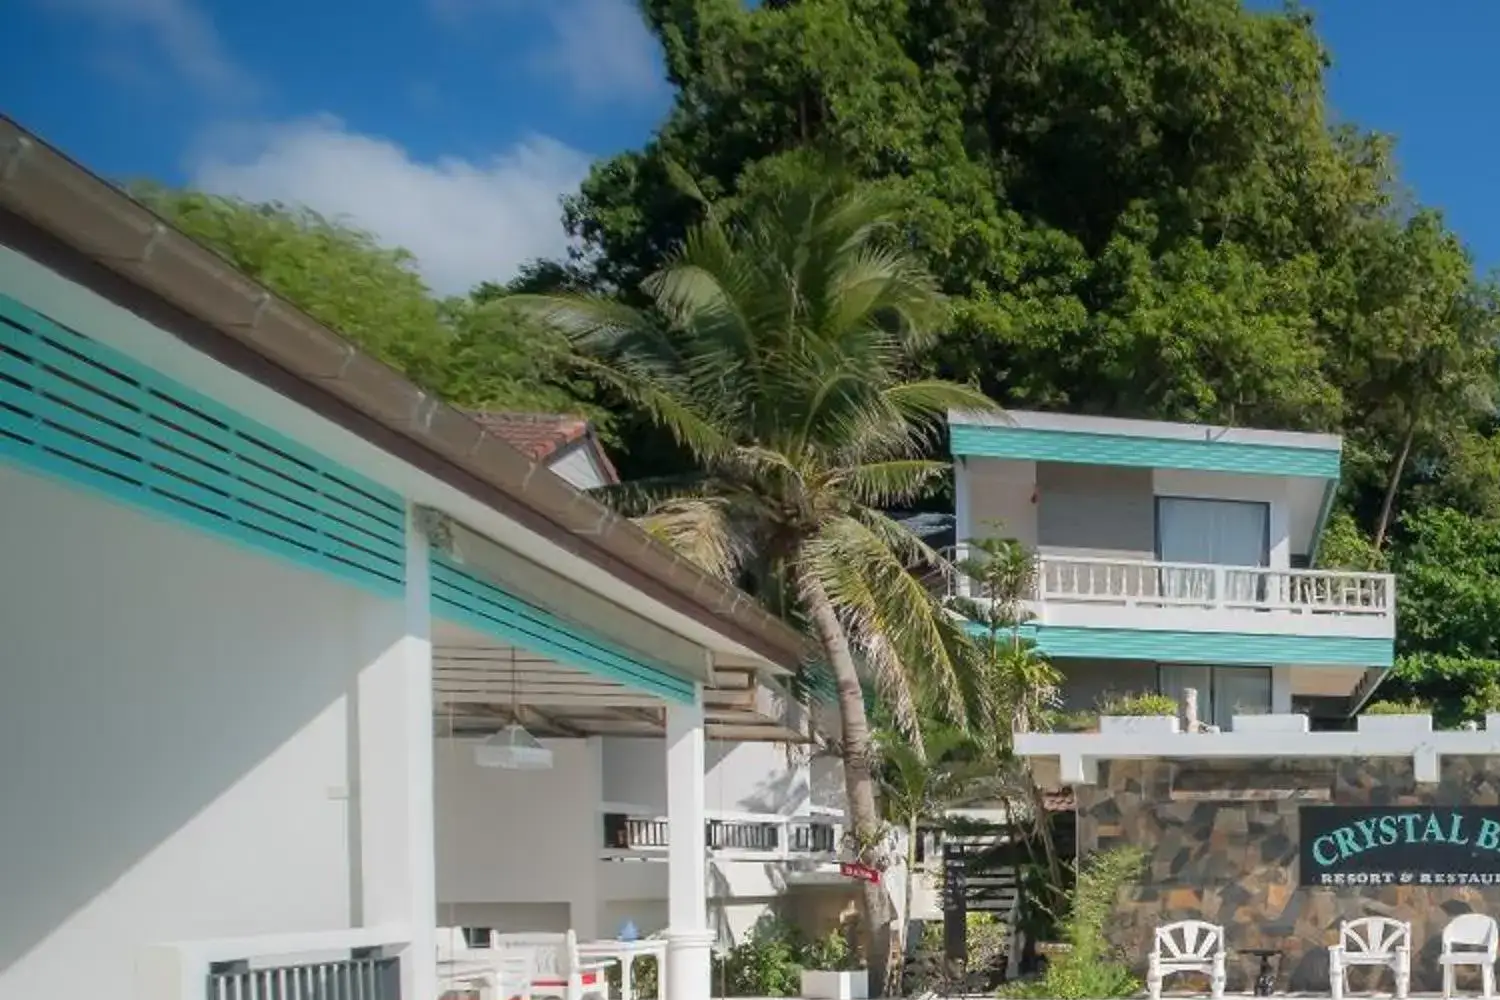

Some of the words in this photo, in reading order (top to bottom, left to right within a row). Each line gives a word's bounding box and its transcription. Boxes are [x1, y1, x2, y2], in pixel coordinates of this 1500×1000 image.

[1312, 811, 1469, 866] CRYSTAL
[1320, 872, 1395, 884] RESORT
[1399, 872, 1413, 884] &
